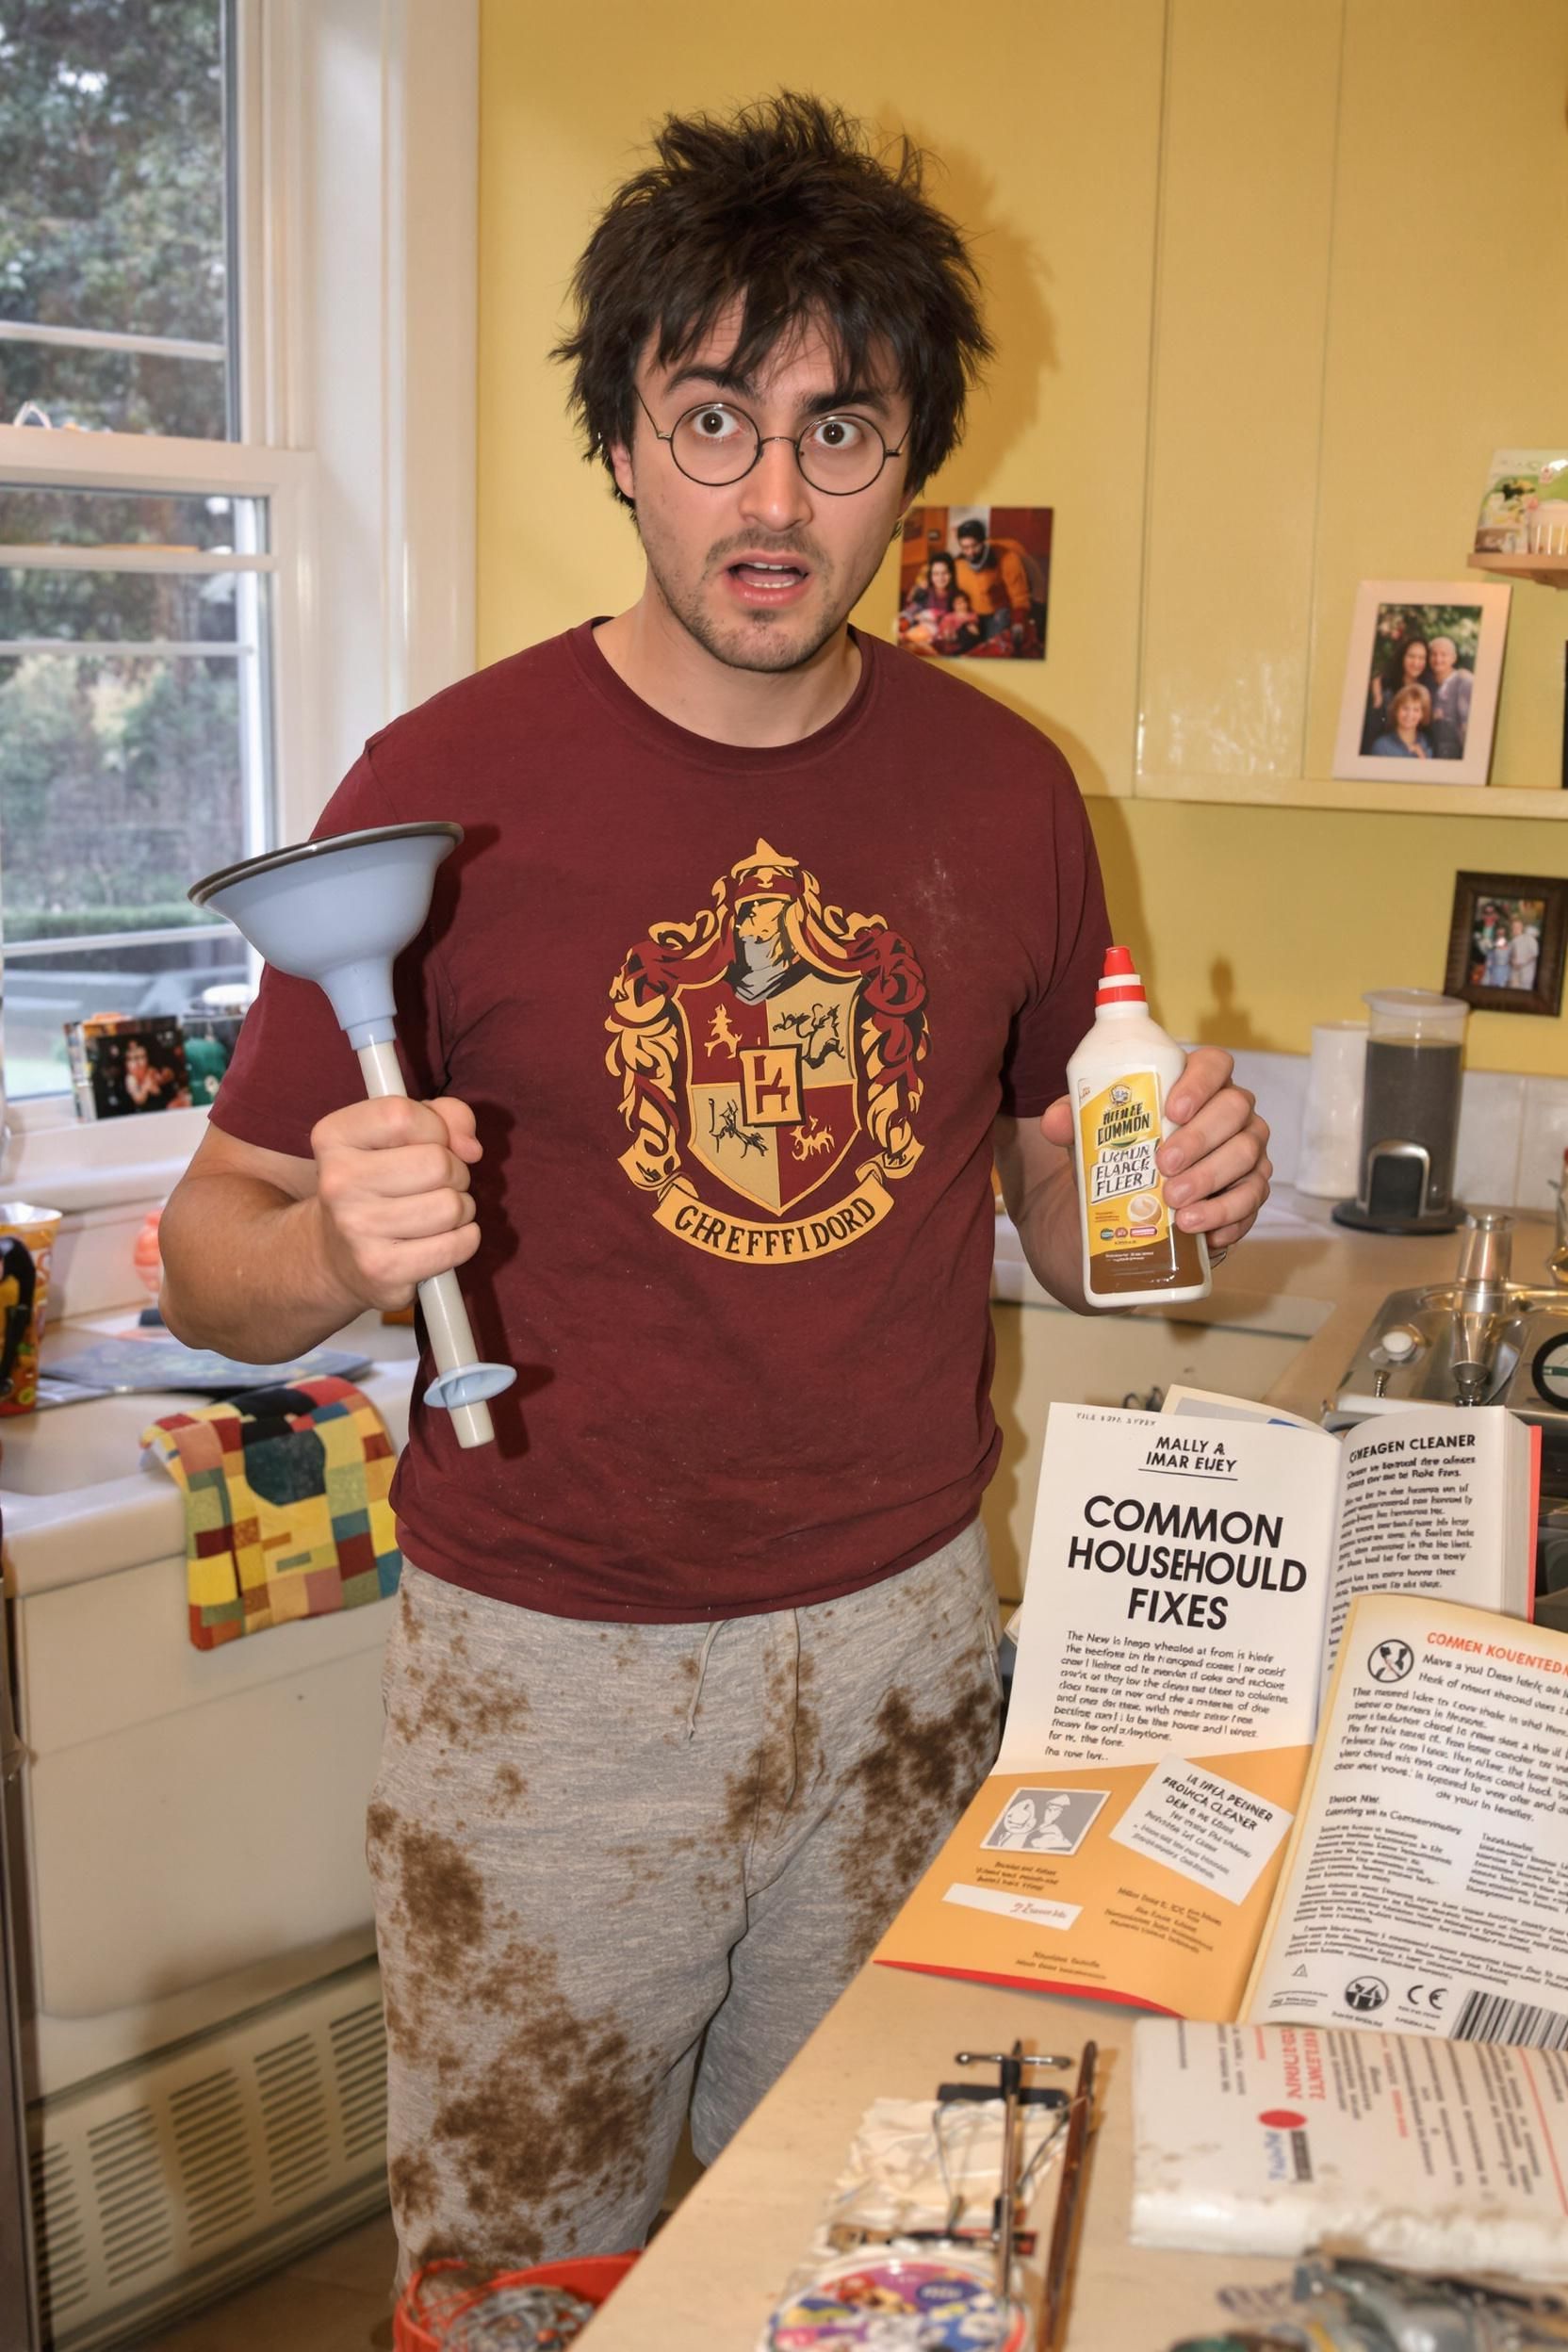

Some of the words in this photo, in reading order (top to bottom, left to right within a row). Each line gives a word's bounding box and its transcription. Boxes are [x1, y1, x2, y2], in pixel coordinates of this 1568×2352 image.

[1155, 1436, 1209, 1454] MALLY
[1410, 1434, 1477, 1450] CLEANER
[1146, 1451, 1189, 1469] IMAR
[1084, 1494, 1284, 1548] COMMON
[1068, 1536, 1308, 1592] HOUSEHOULD
[1128, 1587, 1230, 1630] FIXES
[1211, 1647, 1235, 1659] from
